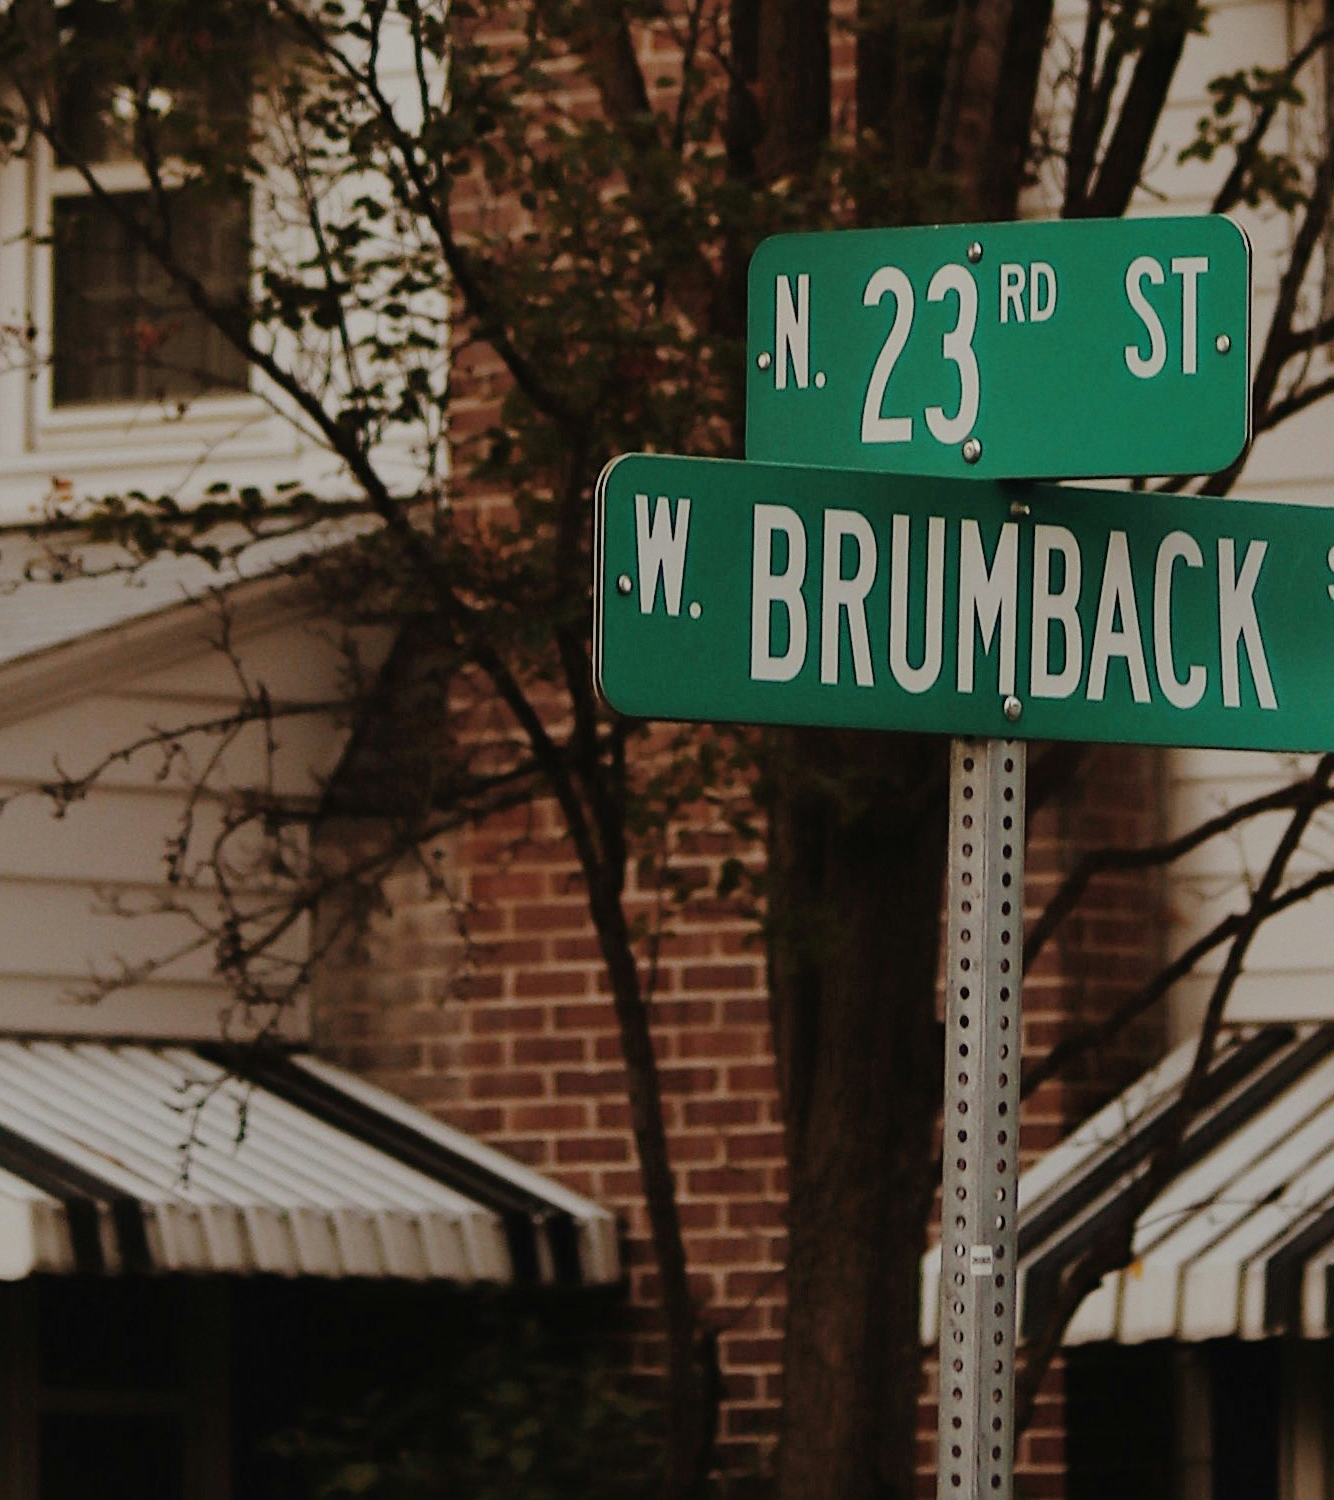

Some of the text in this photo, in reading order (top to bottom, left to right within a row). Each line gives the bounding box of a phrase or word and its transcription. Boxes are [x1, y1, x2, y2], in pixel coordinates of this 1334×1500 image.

[775, 274, 827, 390] N.
[1125, 256, 1209, 378] ST
[635, 494, 702, 619] W.
[751, 504, 1279, 710] BRUMBACK
